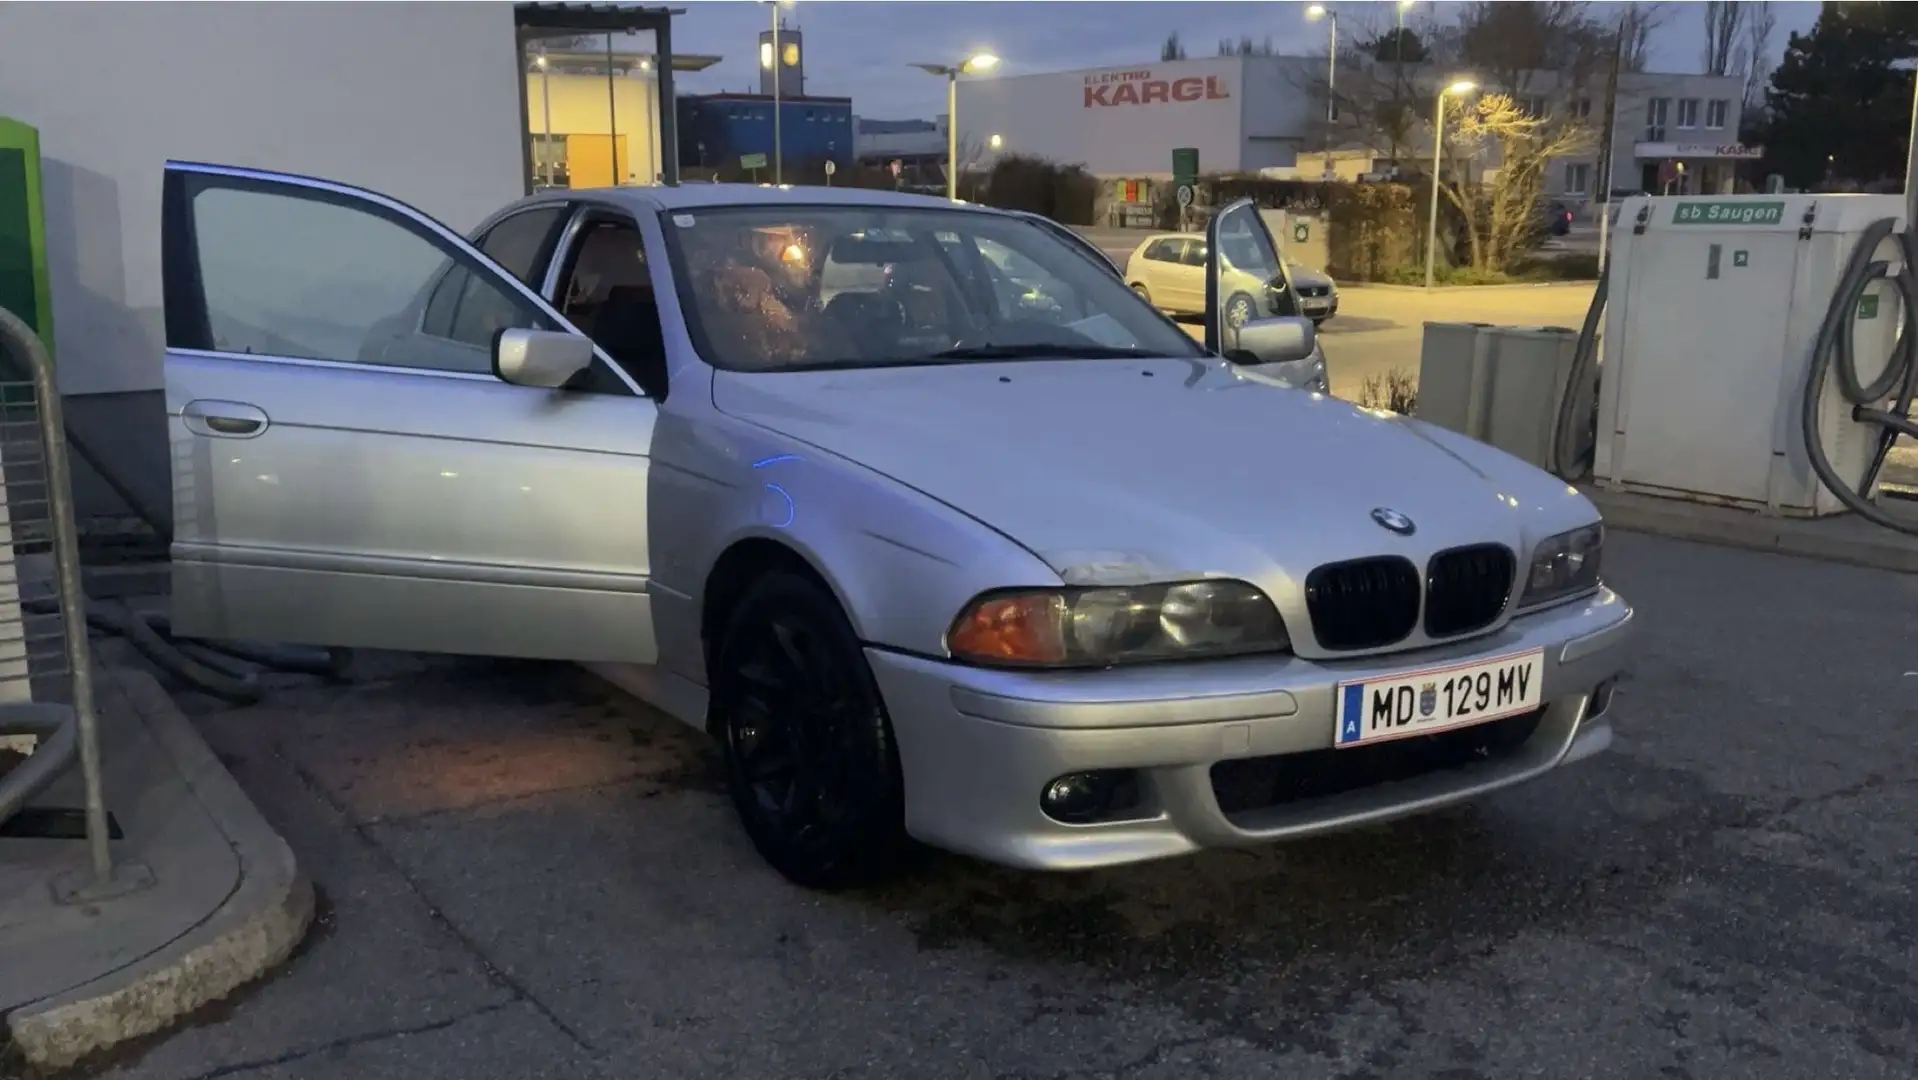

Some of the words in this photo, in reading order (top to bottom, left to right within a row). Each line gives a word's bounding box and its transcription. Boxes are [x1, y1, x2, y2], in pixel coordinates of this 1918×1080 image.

[1084, 70, 1150, 85] ELEKTRO
[1084, 75, 1230, 108] KARGL
[1680, 204, 1701, 218] sb
[1708, 204, 1778, 222] Saugen
[1346, 720, 1356, 734] A
[1371, 685, 1415, 730] MD
[1443, 671, 1491, 718] 129
[1497, 662, 1533, 707] MV
